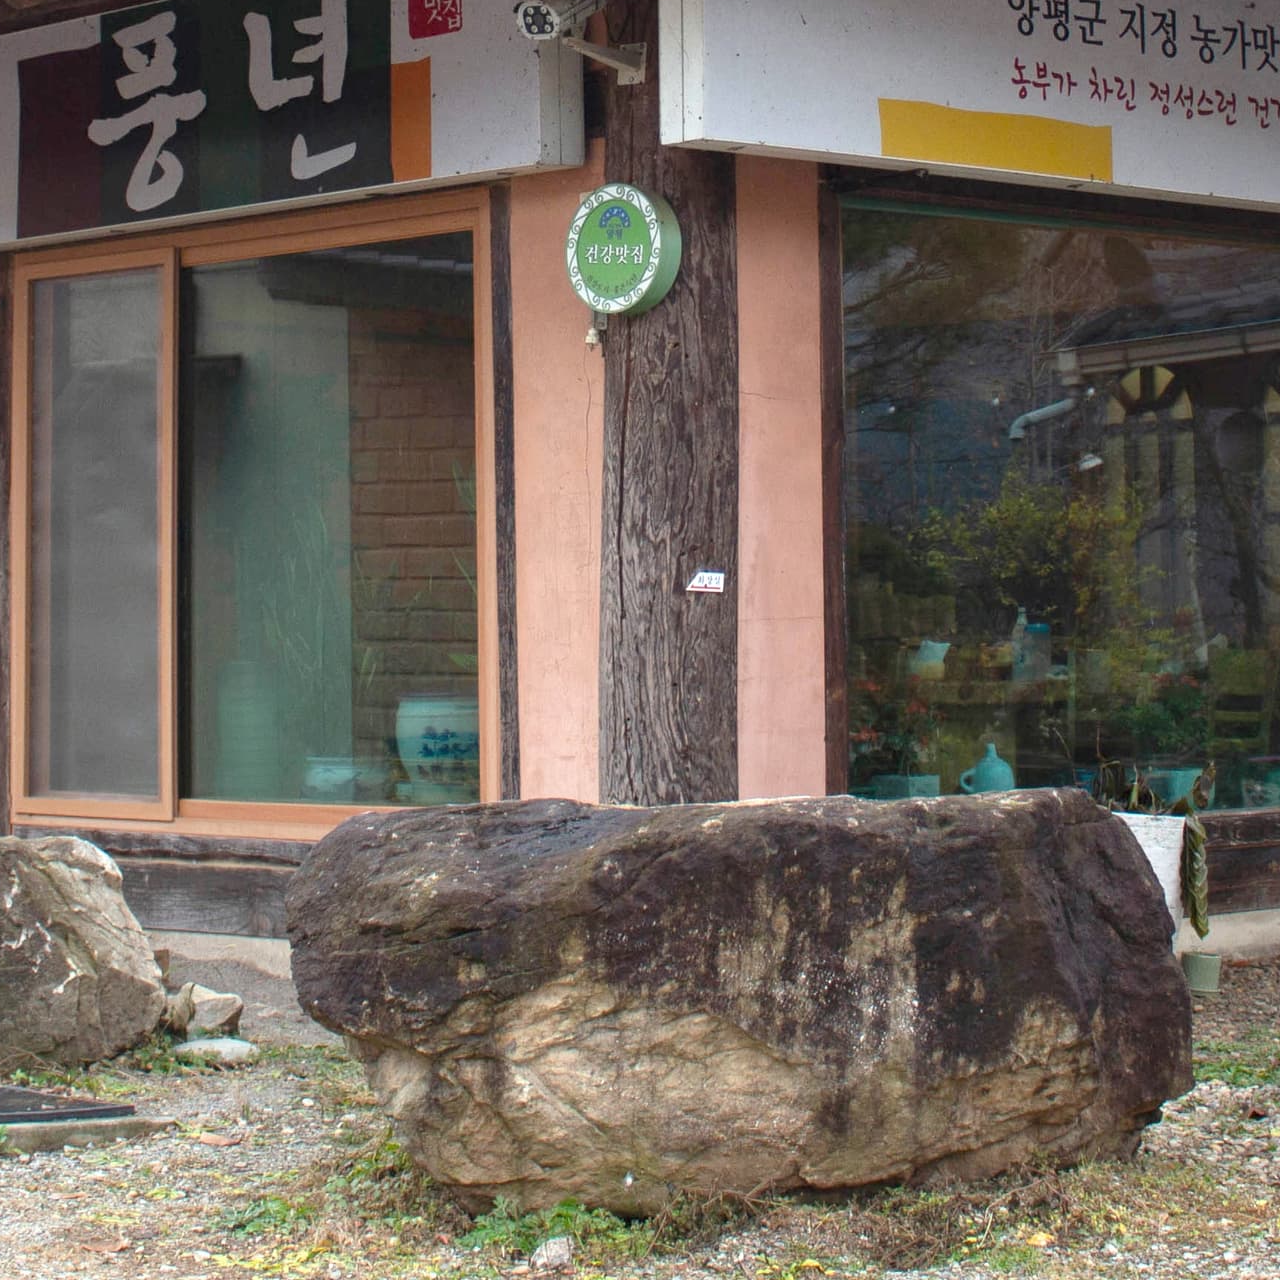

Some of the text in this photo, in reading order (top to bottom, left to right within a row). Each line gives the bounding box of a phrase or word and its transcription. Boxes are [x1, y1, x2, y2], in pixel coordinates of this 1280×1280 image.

[1119, 3, 1179, 59] 지정
[1011, 57, 1078, 101] 농부가
[1088, 67, 1136, 112] 차린
[1149, 81, 1238, 126] 정성스런
[584, 244, 644, 265] 건강맛집
